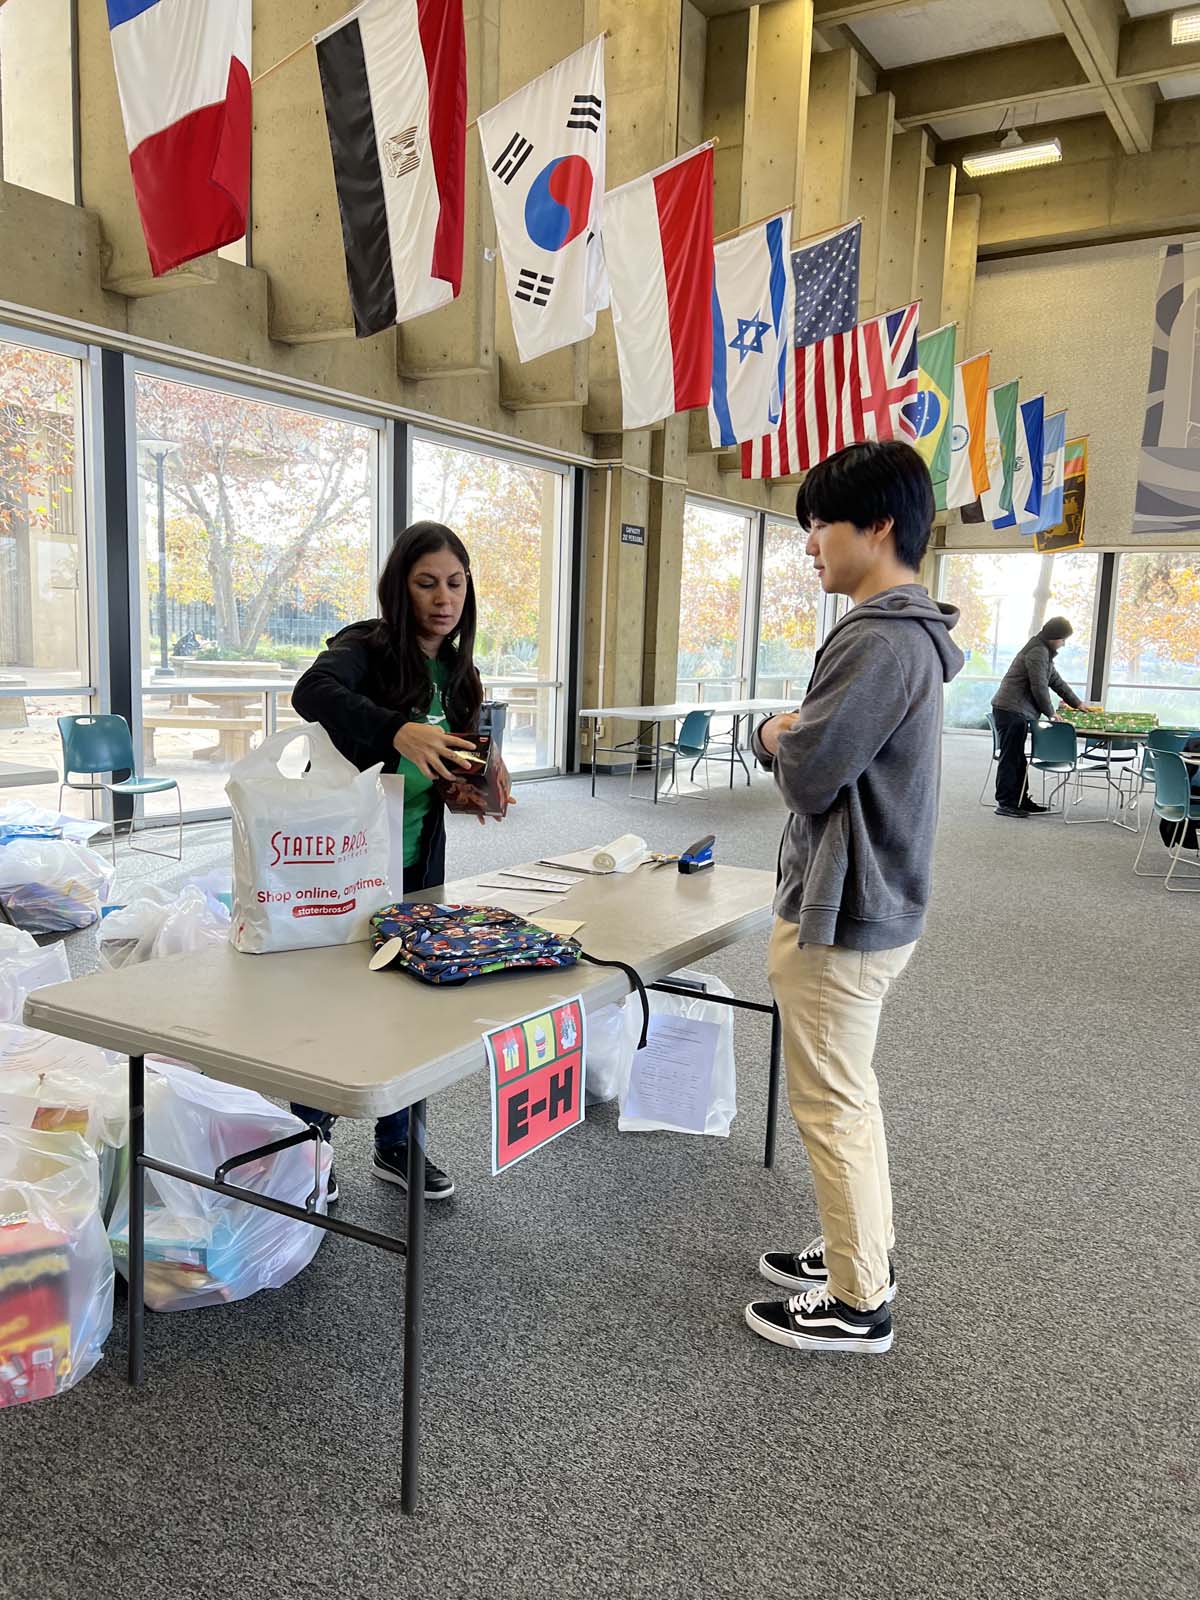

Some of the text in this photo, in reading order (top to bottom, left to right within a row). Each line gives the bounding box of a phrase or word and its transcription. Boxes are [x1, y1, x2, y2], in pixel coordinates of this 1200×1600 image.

[270, 830, 368, 867] STATER BROS.
[257, 877, 386, 904] Shop online, anytime.
[297, 902, 354, 915] staterbros.com
[508, 1066, 573, 1146] E-H
